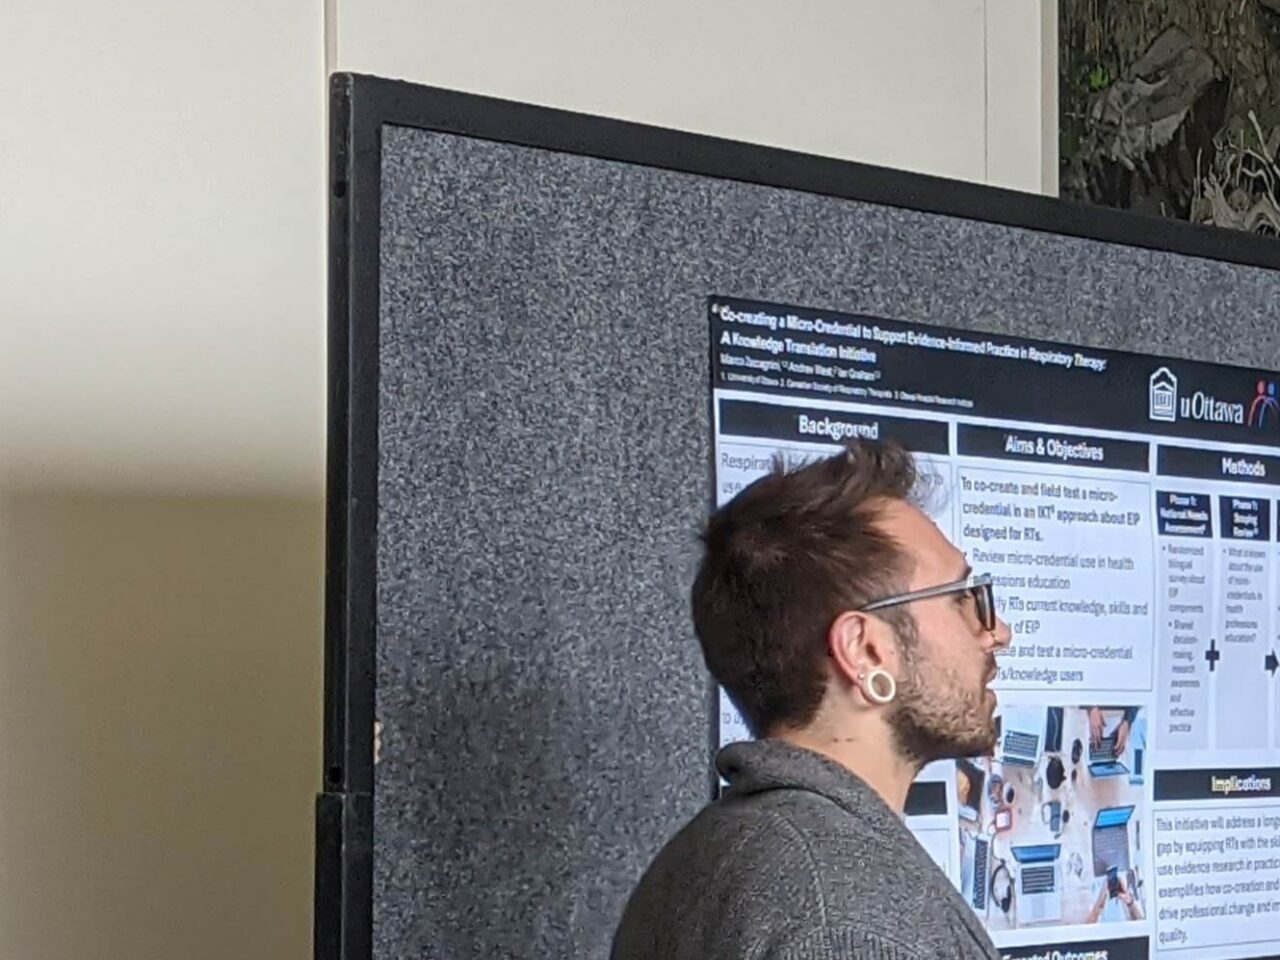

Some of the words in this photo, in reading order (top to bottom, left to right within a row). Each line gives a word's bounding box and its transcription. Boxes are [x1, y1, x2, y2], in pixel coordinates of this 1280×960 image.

[720, 308, 777, 330] Co-creating
[779, 317, 785, 328] a
[786, 314, 861, 338] Micro-Credential
[862, 326, 872, 339] to
[873, 326, 907, 345] Support
[986, 342, 1020, 358] Practice
[1020, 347, 1028, 359] in
[1028, 347, 1074, 368] Respiratory
[720, 331, 731, 345] A
[732, 332, 784, 354] Knowledge
[785, 338, 838, 358] Translation
[839, 345, 877, 363] Initiative
[798, 414, 878, 440] Background
[1005, 434, 1034, 455] Aims
[1036, 437, 1045, 455] &
[1047, 438, 1104, 461] Objectives
[1222, 457, 1267, 477] Methods
[961, 476, 972, 490] To
[974, 479, 1019, 495] co-create
[1021, 482, 1039, 496] and
[1040, 482, 1061, 498] field
[1063, 486, 1080, 499] test
[1082, 489, 1087, 499] a
[1088, 487, 1118, 502] micro-
[962, 500, 1012, 517] credential
[1013, 503, 1021, 517] in
[1023, 506, 1036, 519] an
[1057, 508, 1099, 524] approach
[1099, 511, 1126, 526] about
[1127, 512, 1140, 526] EIP
[963, 524, 1007, 541] designed
[1008, 525, 1022, 540] for
[1023, 527, 1044, 542] RTs.
[972, 548, 1005, 563] Review
[1007, 550, 1079, 568] micro-credential
[1080, 556, 1096, 569] use
[1097, 555, 1105, 569] in
[1107, 556, 1134, 570] health
[1027, 574, 1070, 589] education
[1009, 596, 1024, 611] RTs
[1026, 600, 1058, 612] current
[1059, 600, 1107, 617] knowledge,
[1109, 602, 1130, 615] skills
[1132, 604, 1148, 616] and
[1014, 621, 1023, 634] of
[1025, 620, 1040, 634] EIP
[1018, 645, 1035, 657] and
[1037, 646, 1055, 658] test
[1063, 645, 1133, 660] micro-credential
[1059, 670, 1084, 682] users
[1211, 775, 1271, 795] Implications
[1157, 817, 1173, 831] This
[1174, 815, 1209, 831] initiative
[1210, 815, 1224, 830] will
[1226, 815, 1255, 829] address
[1156, 843, 1172, 857] gap
[1174, 841, 1183, 855] by
[1185, 839, 1225, 855] equipping
[1225, 836, 1239, 849] RTs
[1240, 837, 1255, 848] with
[1257, 836, 1269, 848] the
[1157, 864, 1174, 876] use
[1174, 861, 1210, 875] evidence
[1212, 859, 1245, 872] research
[1246, 859, 1253, 871] in
[1158, 883, 1204, 899] exemplifies
[1205, 882, 1222, 895] how
[1222, 879, 1265, 894] co-creation
[1266, 878, 1279, 891] and
[1159, 907, 1179, 920] drive
[1180, 903, 1228, 921] professional
[1229, 902, 1255, 918] change
[1256, 900, 1270, 913] and
[1159, 928, 1188, 944] quality.
